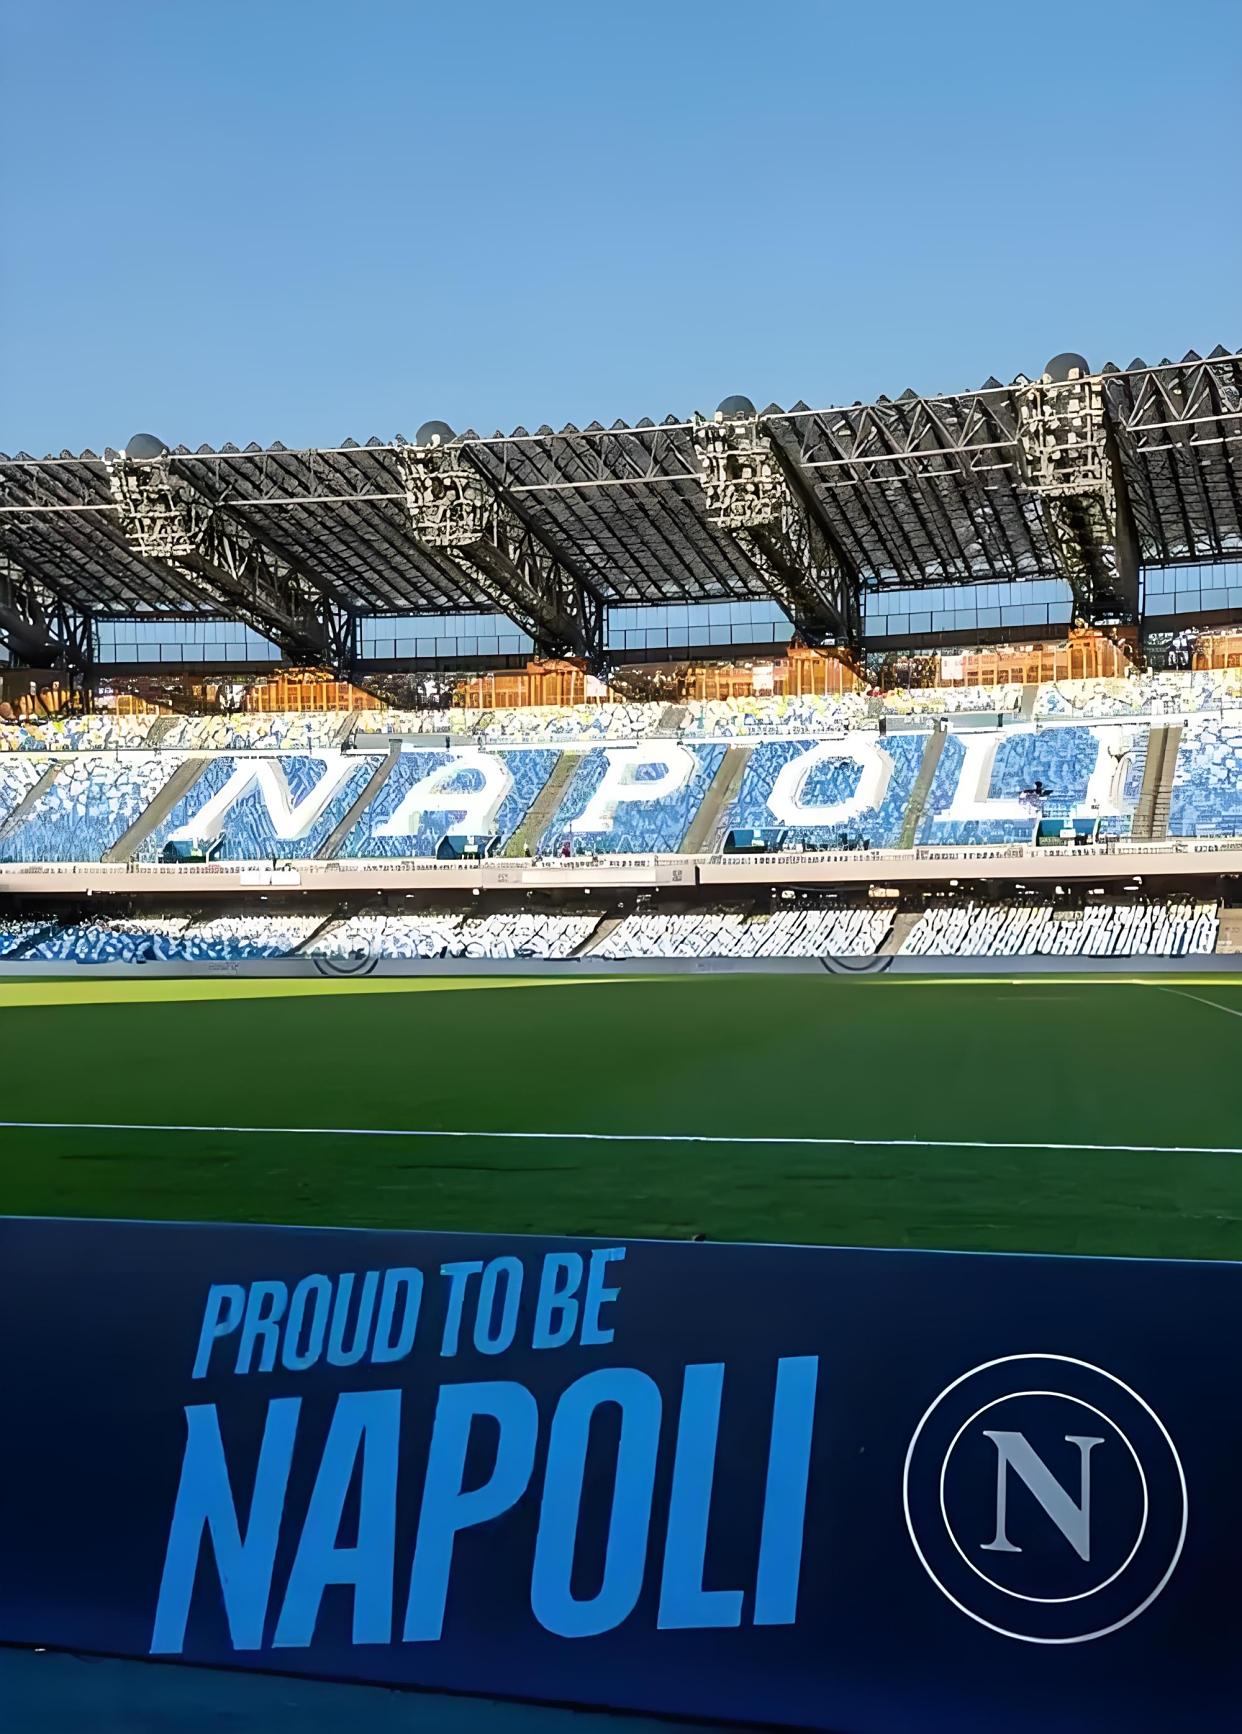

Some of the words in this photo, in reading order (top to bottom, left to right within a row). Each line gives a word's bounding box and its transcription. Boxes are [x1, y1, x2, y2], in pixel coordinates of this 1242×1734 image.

[168, 727, 1130, 842] NAPOLI
[192, 1268, 424, 1378] PROUD
[440, 1256, 524, 1356] TO
[532, 1247, 626, 1348] BE
[150, 1355, 819, 1655] NAPOLI
[980, 1430, 1105, 1561] N
